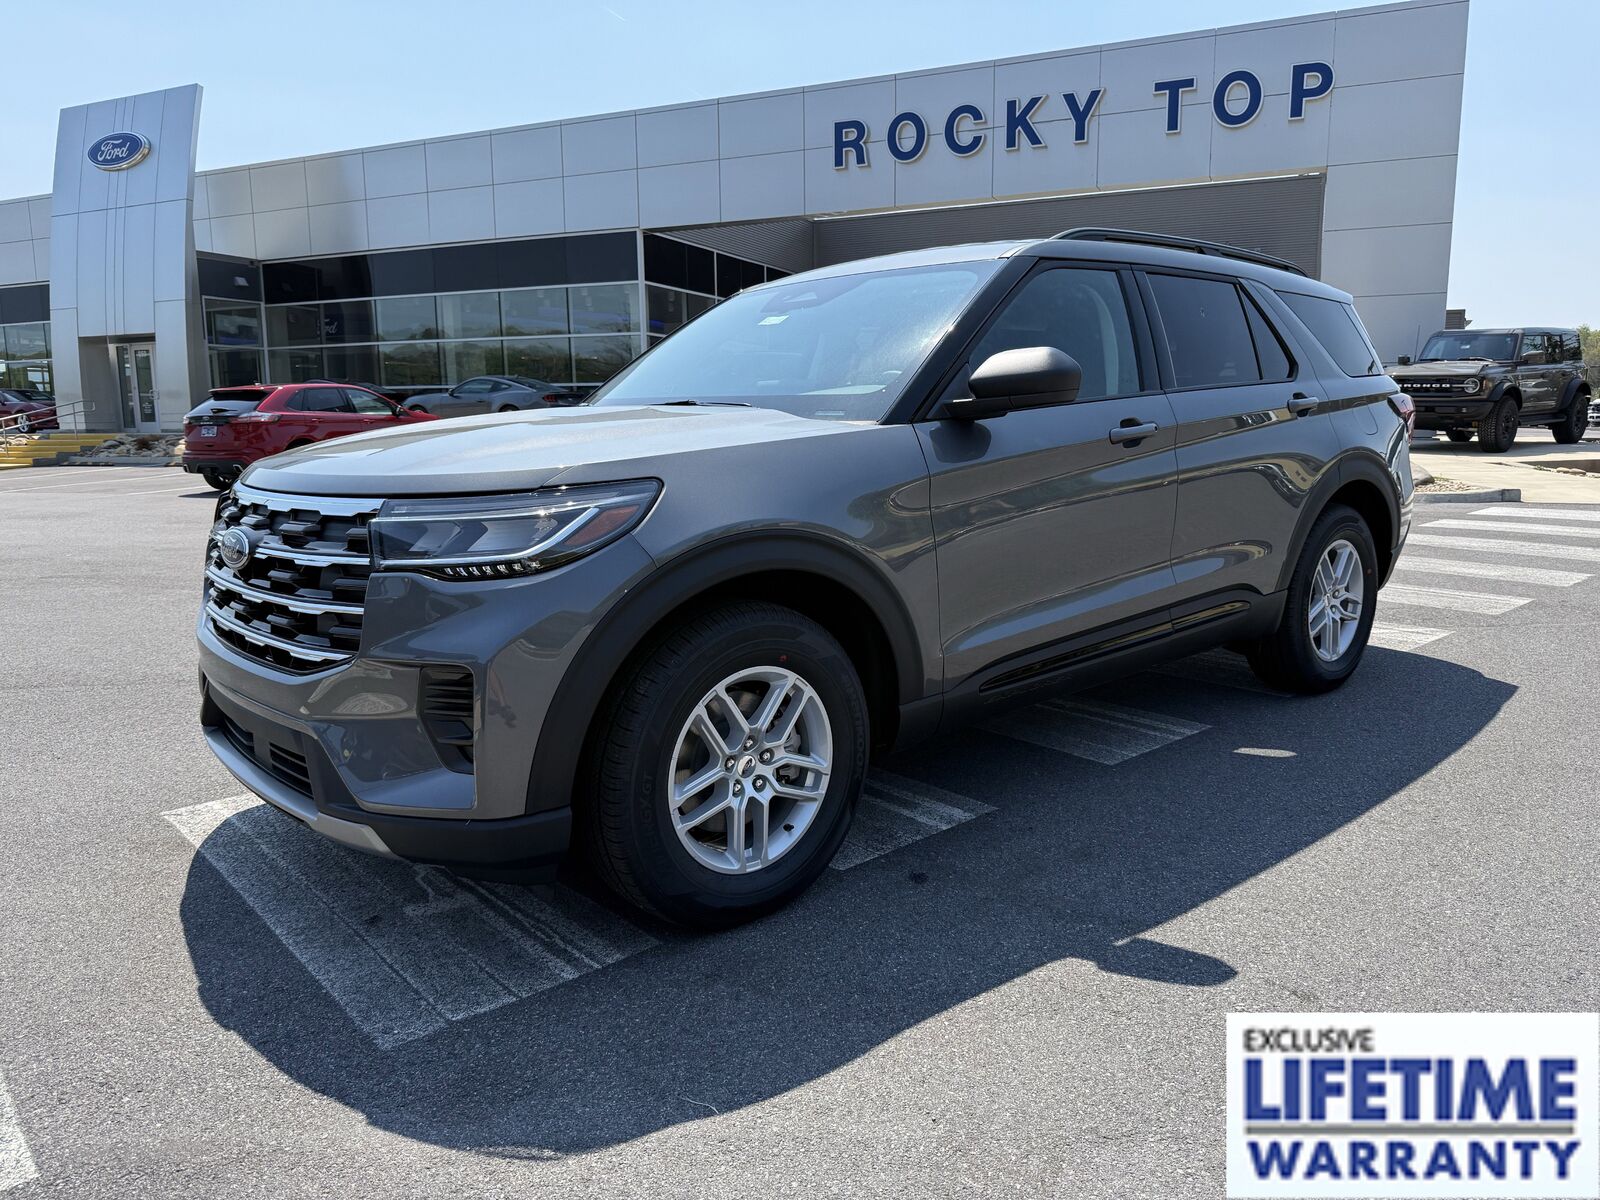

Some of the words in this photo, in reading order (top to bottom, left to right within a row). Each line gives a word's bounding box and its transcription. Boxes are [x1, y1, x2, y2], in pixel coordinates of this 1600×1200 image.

[834, 88, 1104, 168] ROCKY
[1154, 61, 1334, 133] TOP
[97, 139, 130, 161] Ford
